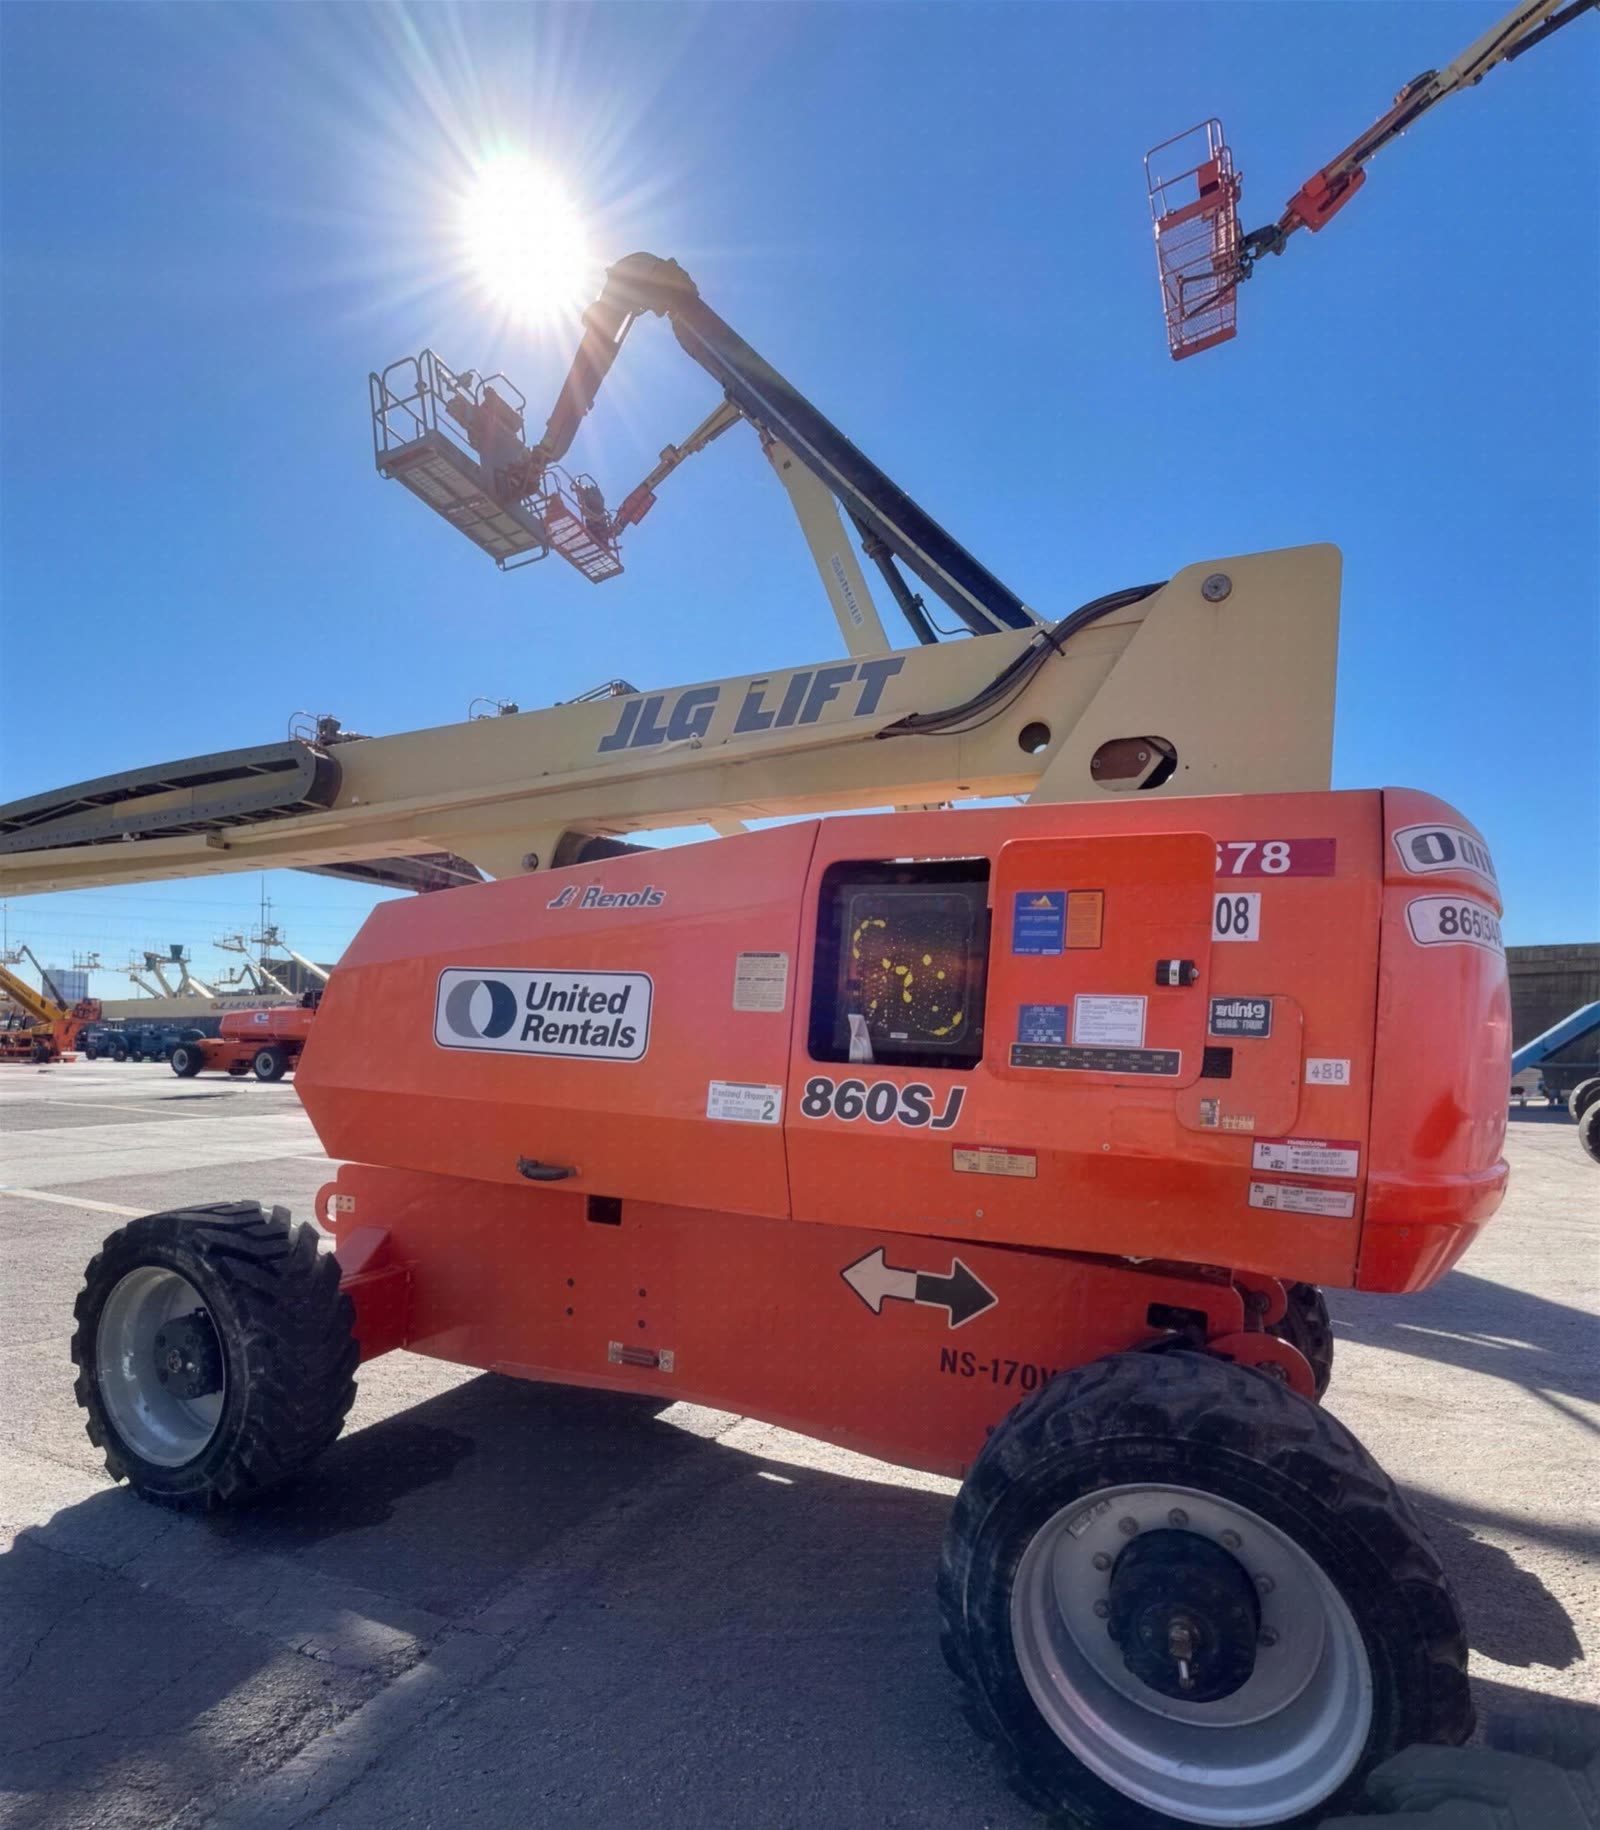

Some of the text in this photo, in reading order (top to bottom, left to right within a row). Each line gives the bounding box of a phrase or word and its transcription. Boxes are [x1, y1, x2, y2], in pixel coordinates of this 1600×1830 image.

[598, 656, 906, 752] JLG LIFT
[1215, 896, 1250, 935] 08
[525, 981, 632, 1014] United
[520, 1013, 637, 1048] Rentals
[801, 1076, 967, 1130] 860SJ
